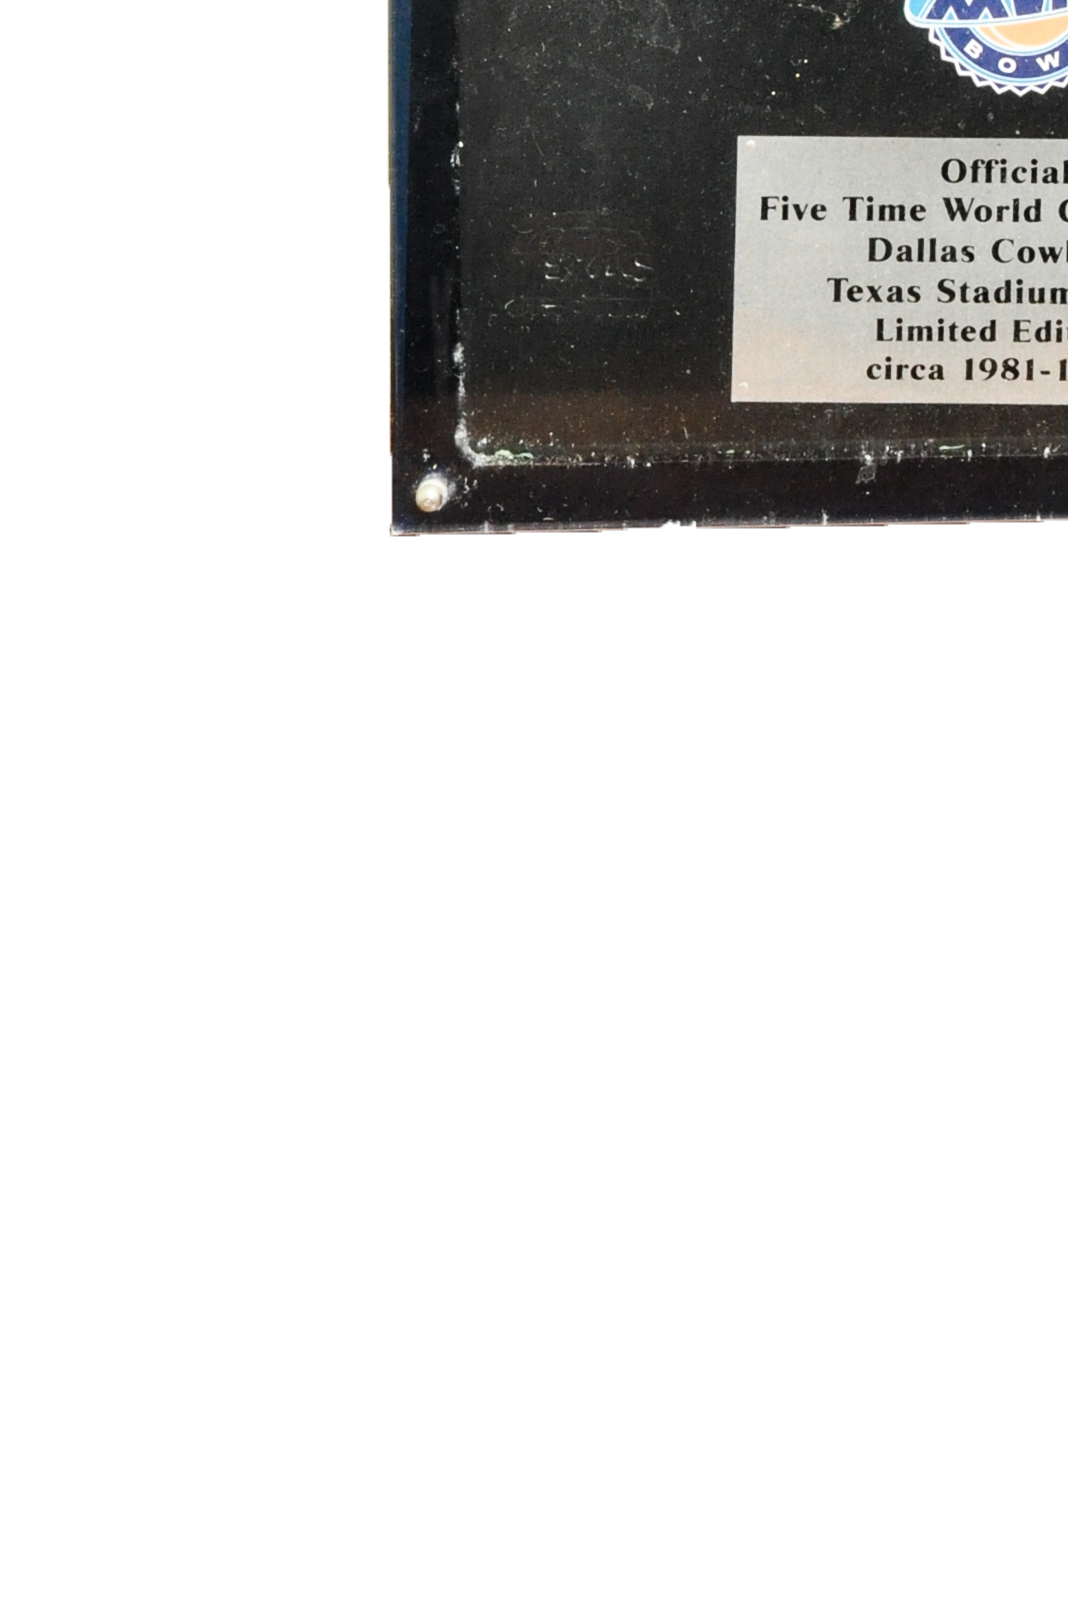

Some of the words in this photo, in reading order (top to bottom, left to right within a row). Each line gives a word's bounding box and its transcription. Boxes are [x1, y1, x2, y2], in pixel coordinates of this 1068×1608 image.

[761, 196, 826, 220] Five
[843, 196, 926, 221] Time
[943, 198, 1041, 222] World
[869, 238, 974, 262] Dallas
[828, 278, 920, 302] Texas
[877, 318, 996, 341] Limited
[867, 357, 944, 380] circa
